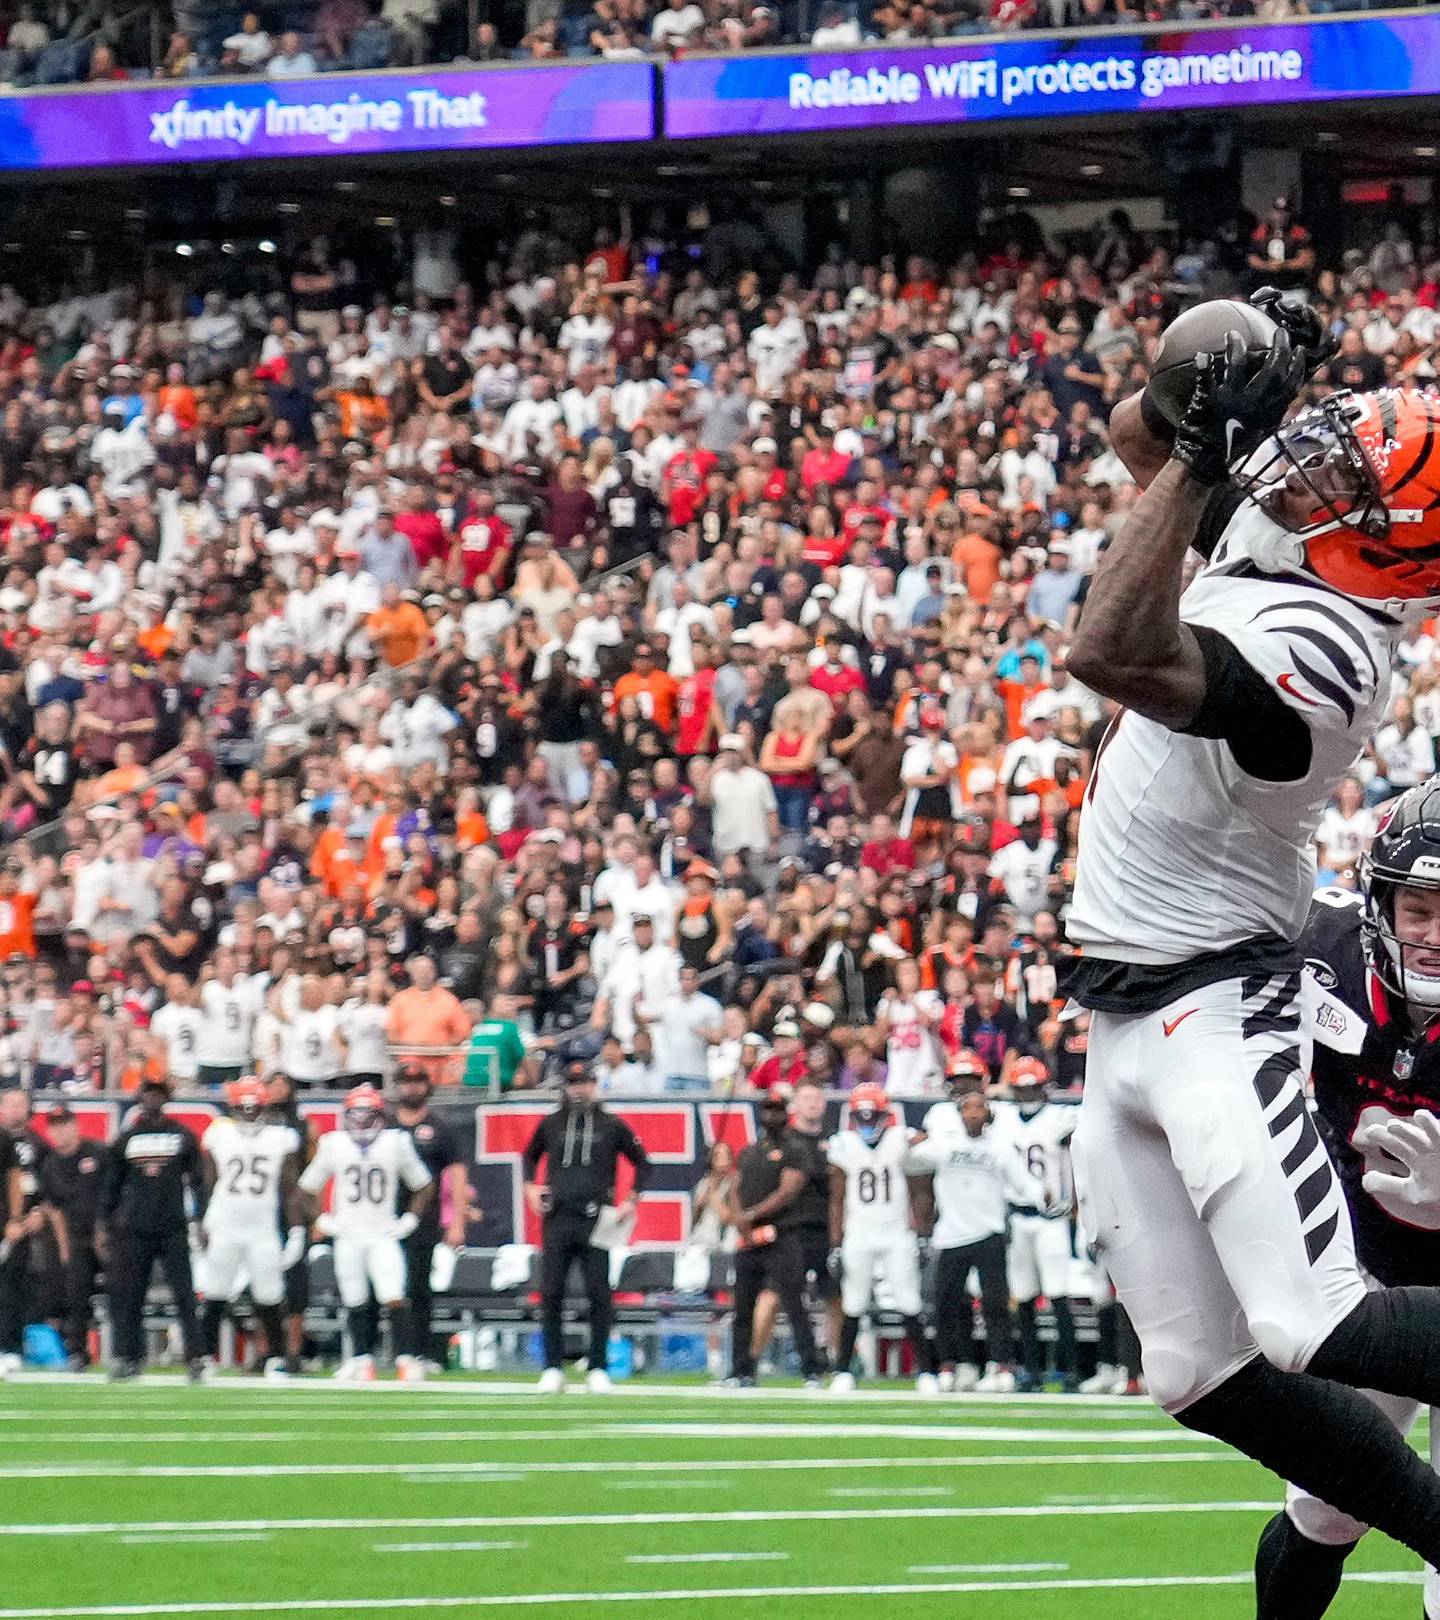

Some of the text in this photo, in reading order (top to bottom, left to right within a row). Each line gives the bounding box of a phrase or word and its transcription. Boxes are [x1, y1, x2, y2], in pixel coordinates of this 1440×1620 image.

[788, 45, 1303, 109] Reliable WiFi protects gametime
[150, 90, 486, 148] xfinity Imagine That
[226, 1156, 270, 1196] 25
[343, 1166, 387, 1206] 30
[857, 1168, 892, 1204] 81
